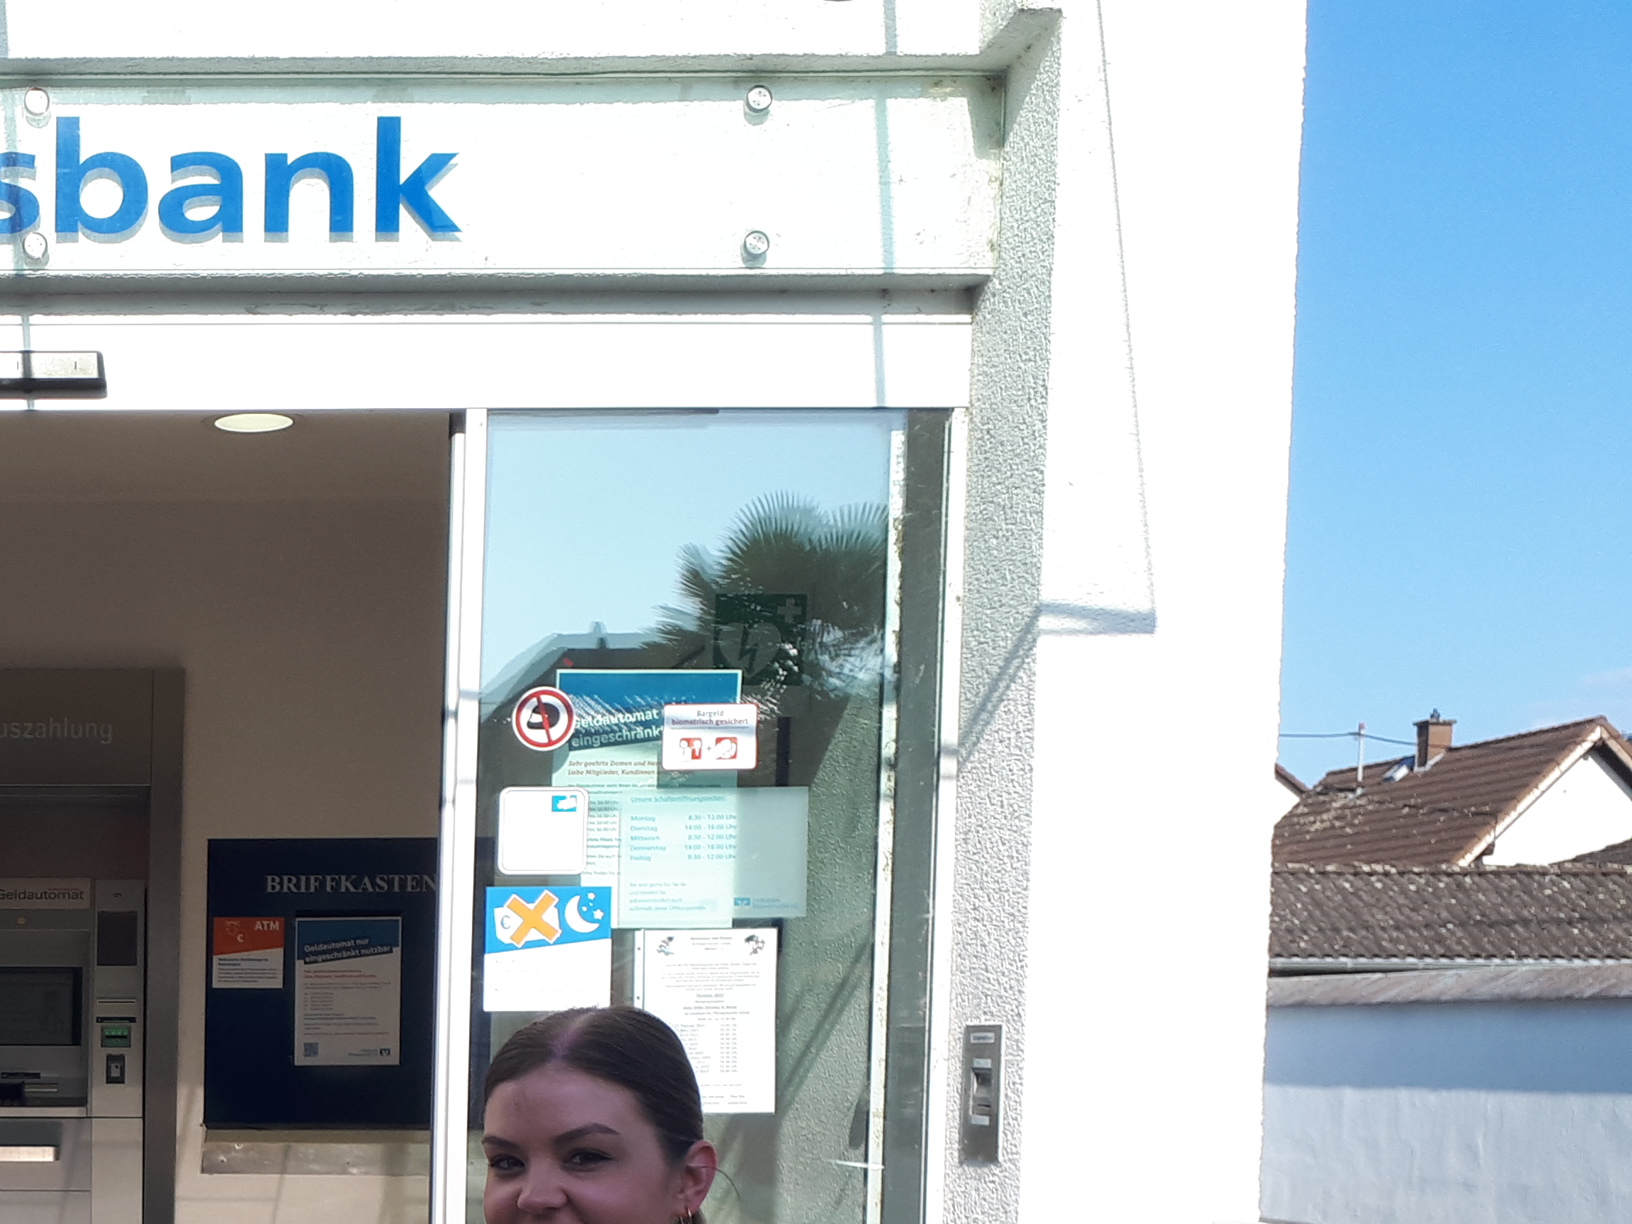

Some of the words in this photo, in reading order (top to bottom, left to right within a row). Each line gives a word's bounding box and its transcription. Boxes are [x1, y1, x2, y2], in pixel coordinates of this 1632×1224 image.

[697, 710, 724, 718] Bargeld
[715, 718, 749, 727] gesichert
[254, 921, 279, 930] ATM
[304, 940, 355, 953] Geldautomat
[305, 950, 360, 962] eingeschränkt
[361, 946, 392, 956] nutzbar
